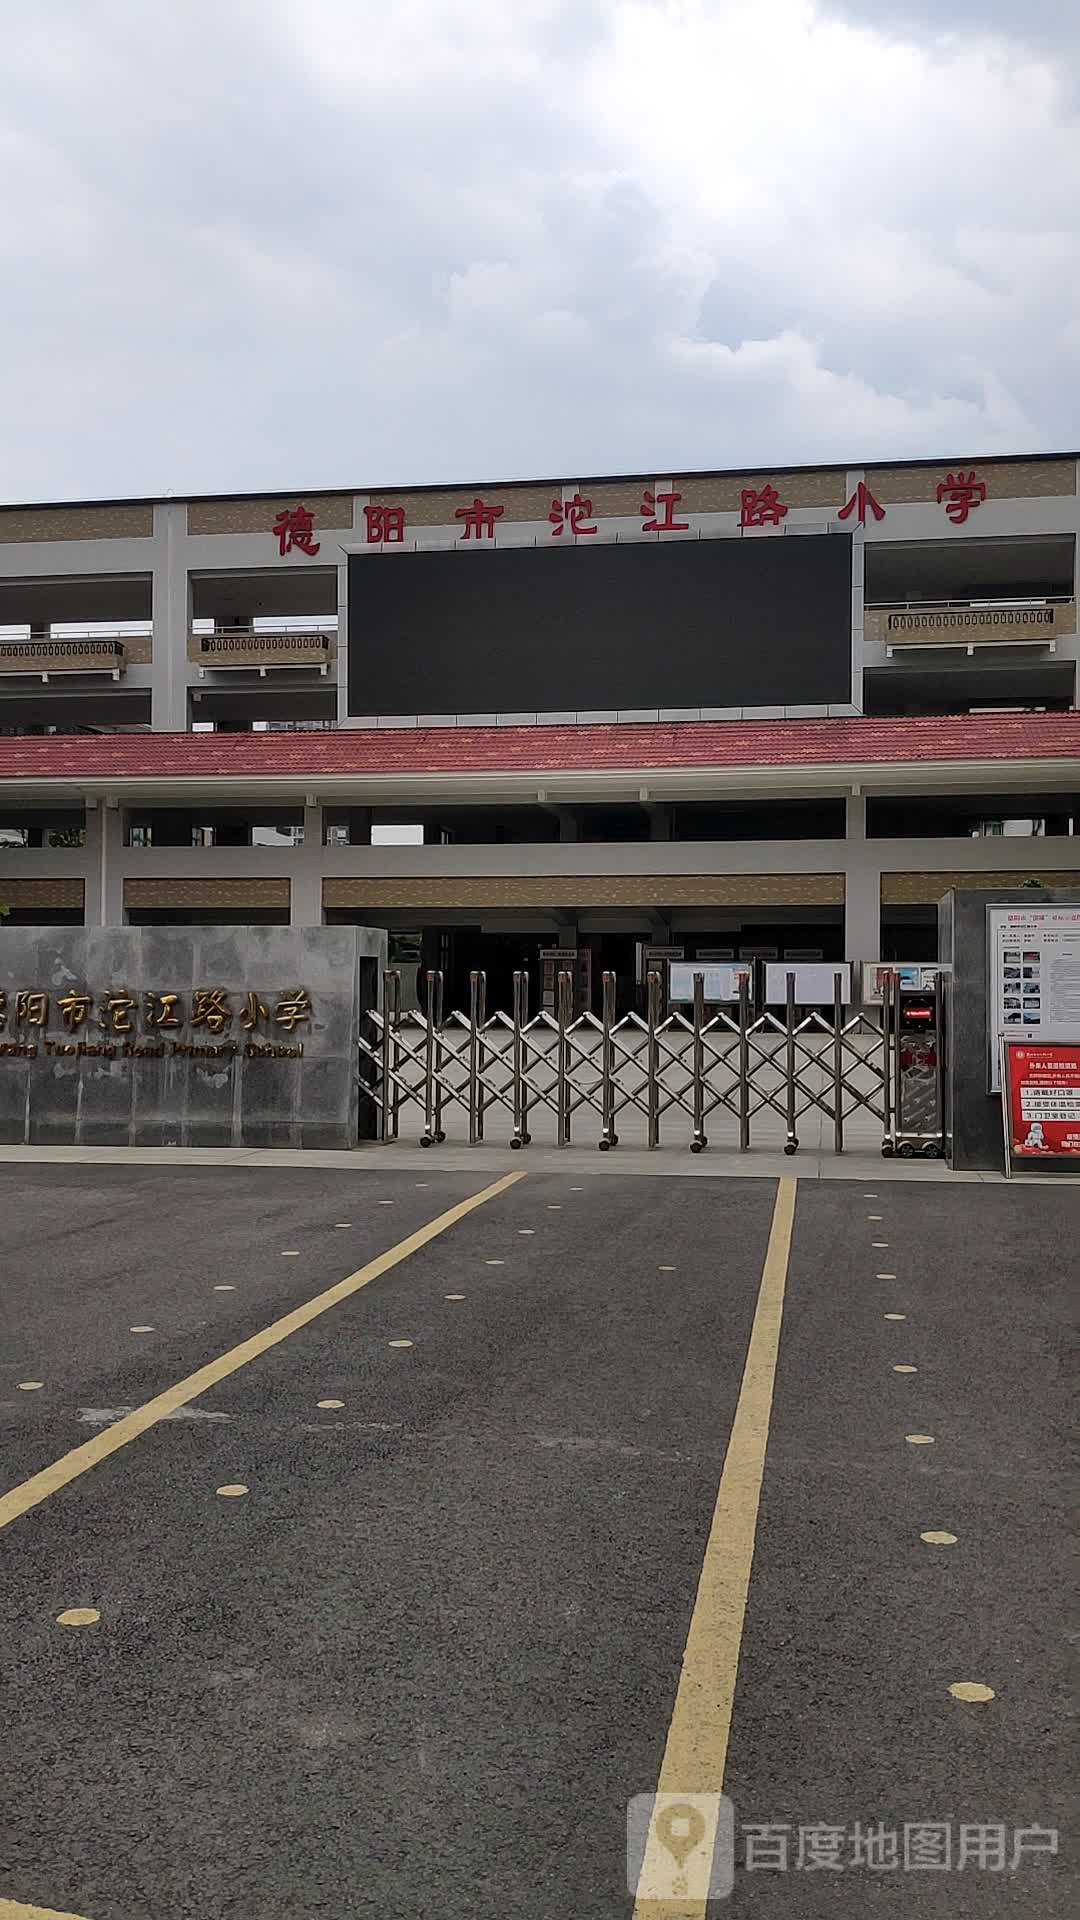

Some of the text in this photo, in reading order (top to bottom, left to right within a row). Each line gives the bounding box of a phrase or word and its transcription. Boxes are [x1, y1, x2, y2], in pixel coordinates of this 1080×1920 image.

[273, 471, 987, 557] 德阳市沱江路小学
